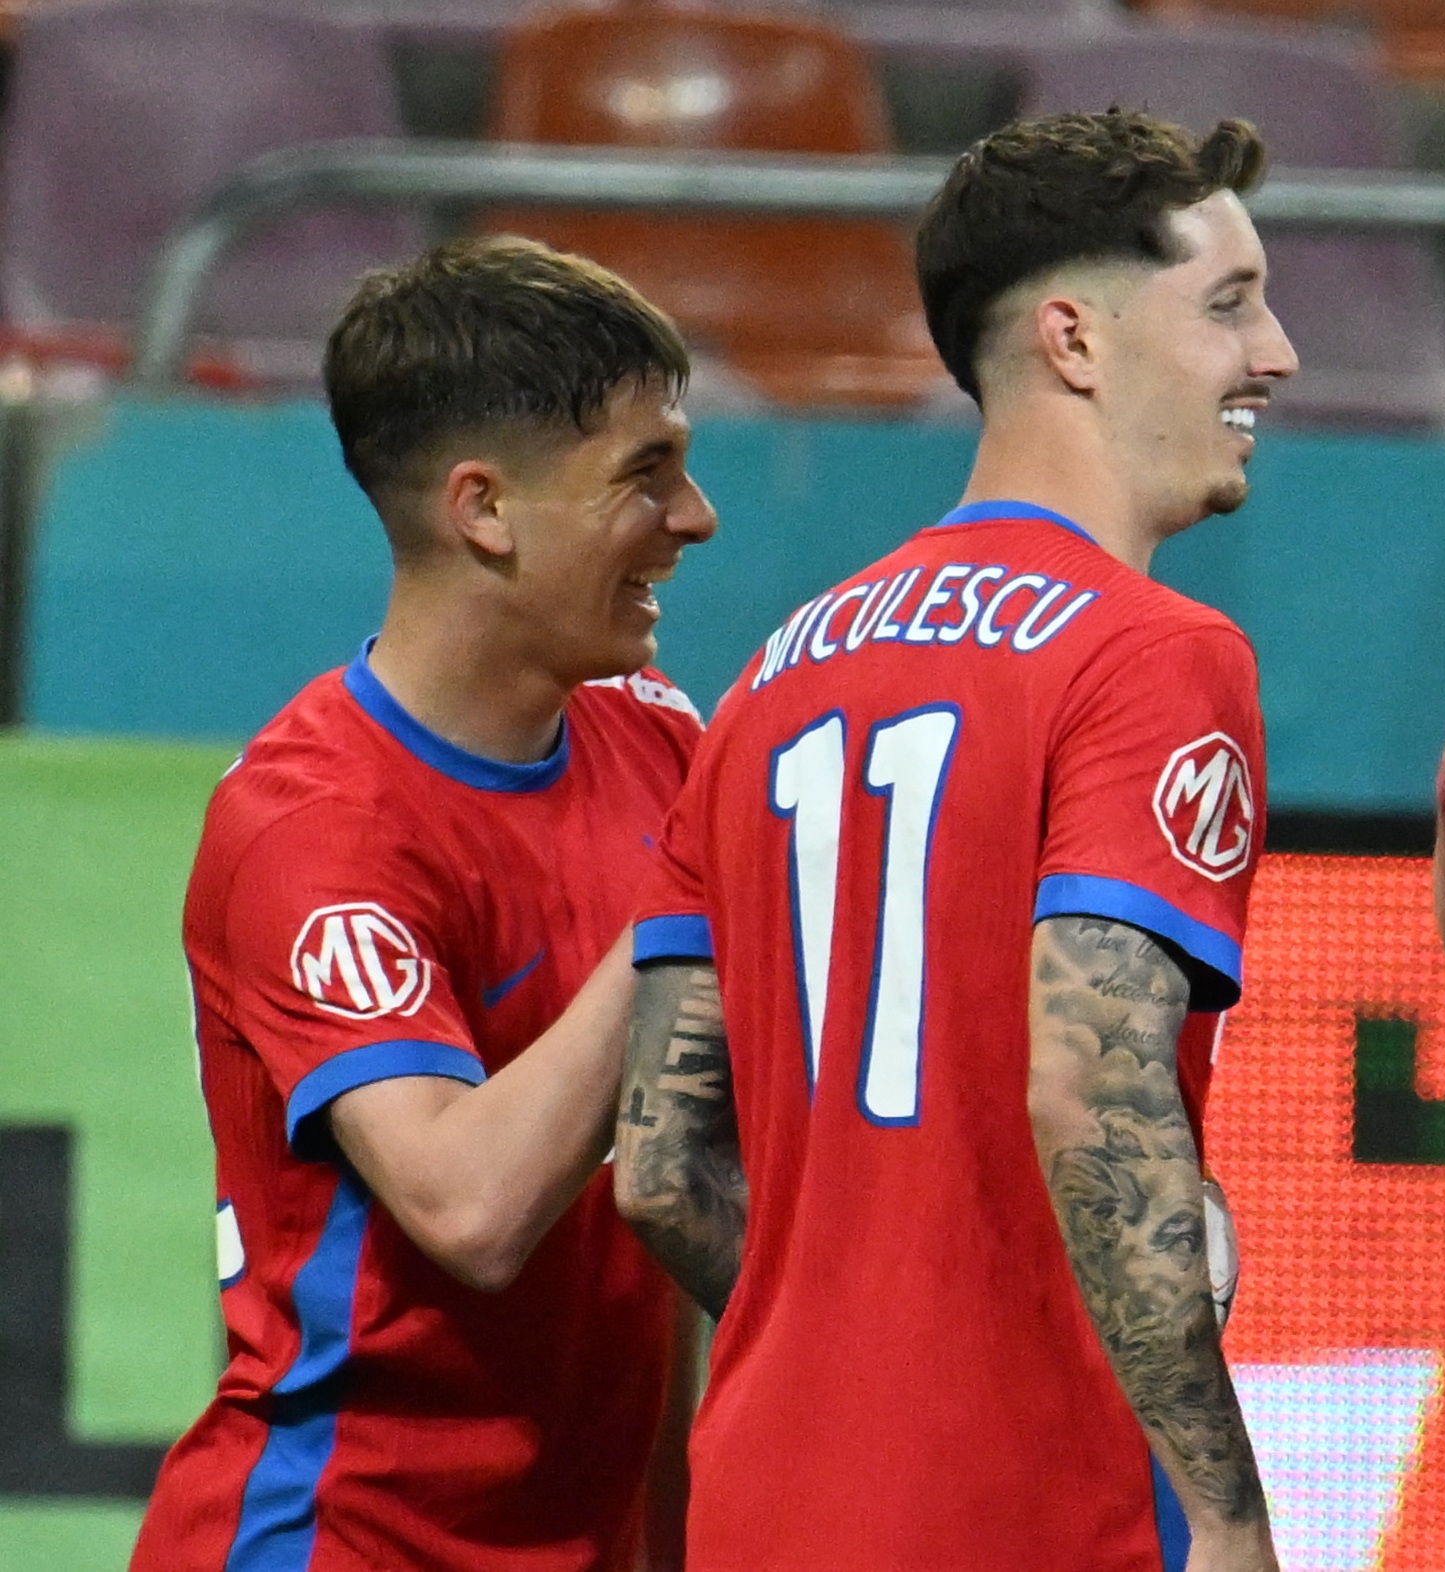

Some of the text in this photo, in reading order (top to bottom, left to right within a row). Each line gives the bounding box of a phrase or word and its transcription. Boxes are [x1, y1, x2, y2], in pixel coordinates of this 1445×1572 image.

[750, 563, 1101, 692] MICULESCU
[1166, 748, 1251, 867] MG
[302, 914, 419, 1011] MG
[768, 701, 962, 1127] 11
